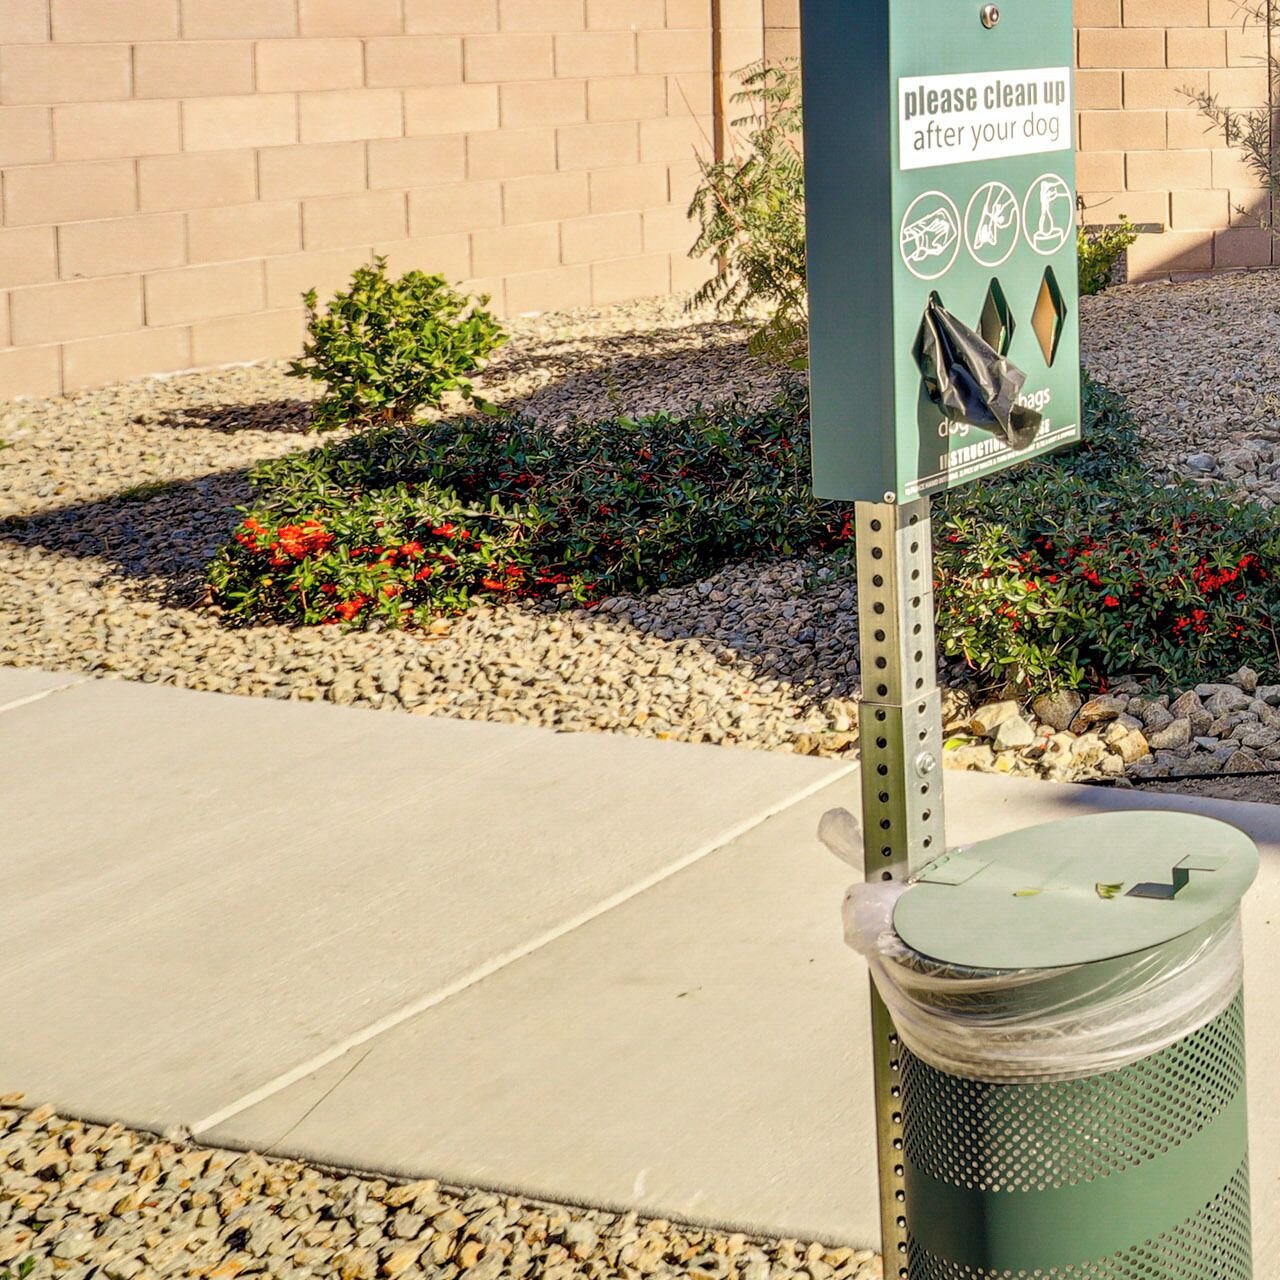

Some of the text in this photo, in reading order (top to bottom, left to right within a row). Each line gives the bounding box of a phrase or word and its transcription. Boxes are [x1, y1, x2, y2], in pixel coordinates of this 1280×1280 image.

[904, 80, 1065, 120] please clean up
[913, 111, 1060, 152] after your dog
[1018, 387, 1050, 412] bags
